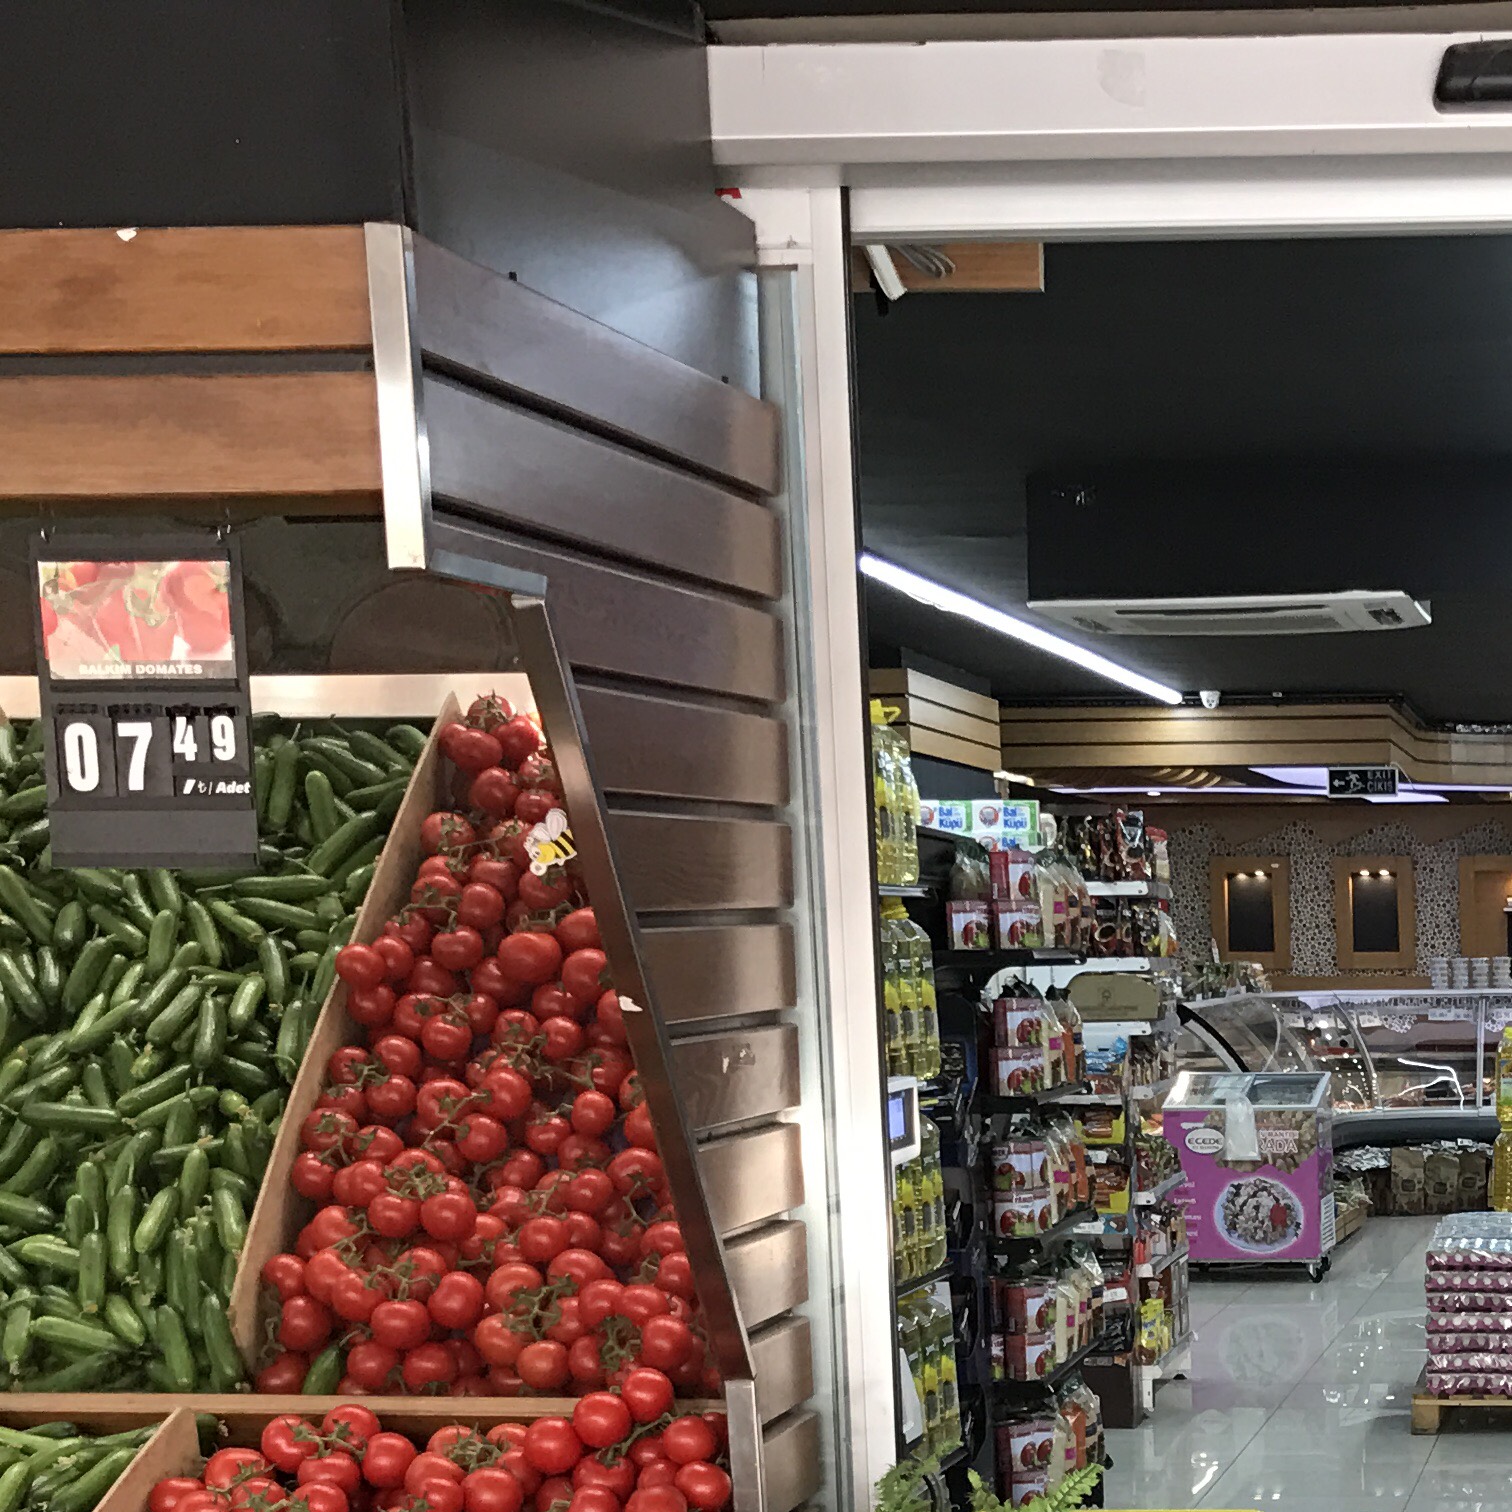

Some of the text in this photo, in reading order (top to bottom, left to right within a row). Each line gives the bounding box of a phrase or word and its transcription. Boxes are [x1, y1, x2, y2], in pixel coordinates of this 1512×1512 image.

[135, 664, 203, 675] DOMATES
[939, 806, 953, 817] Bal
[1003, 806, 1017, 817] Bal
